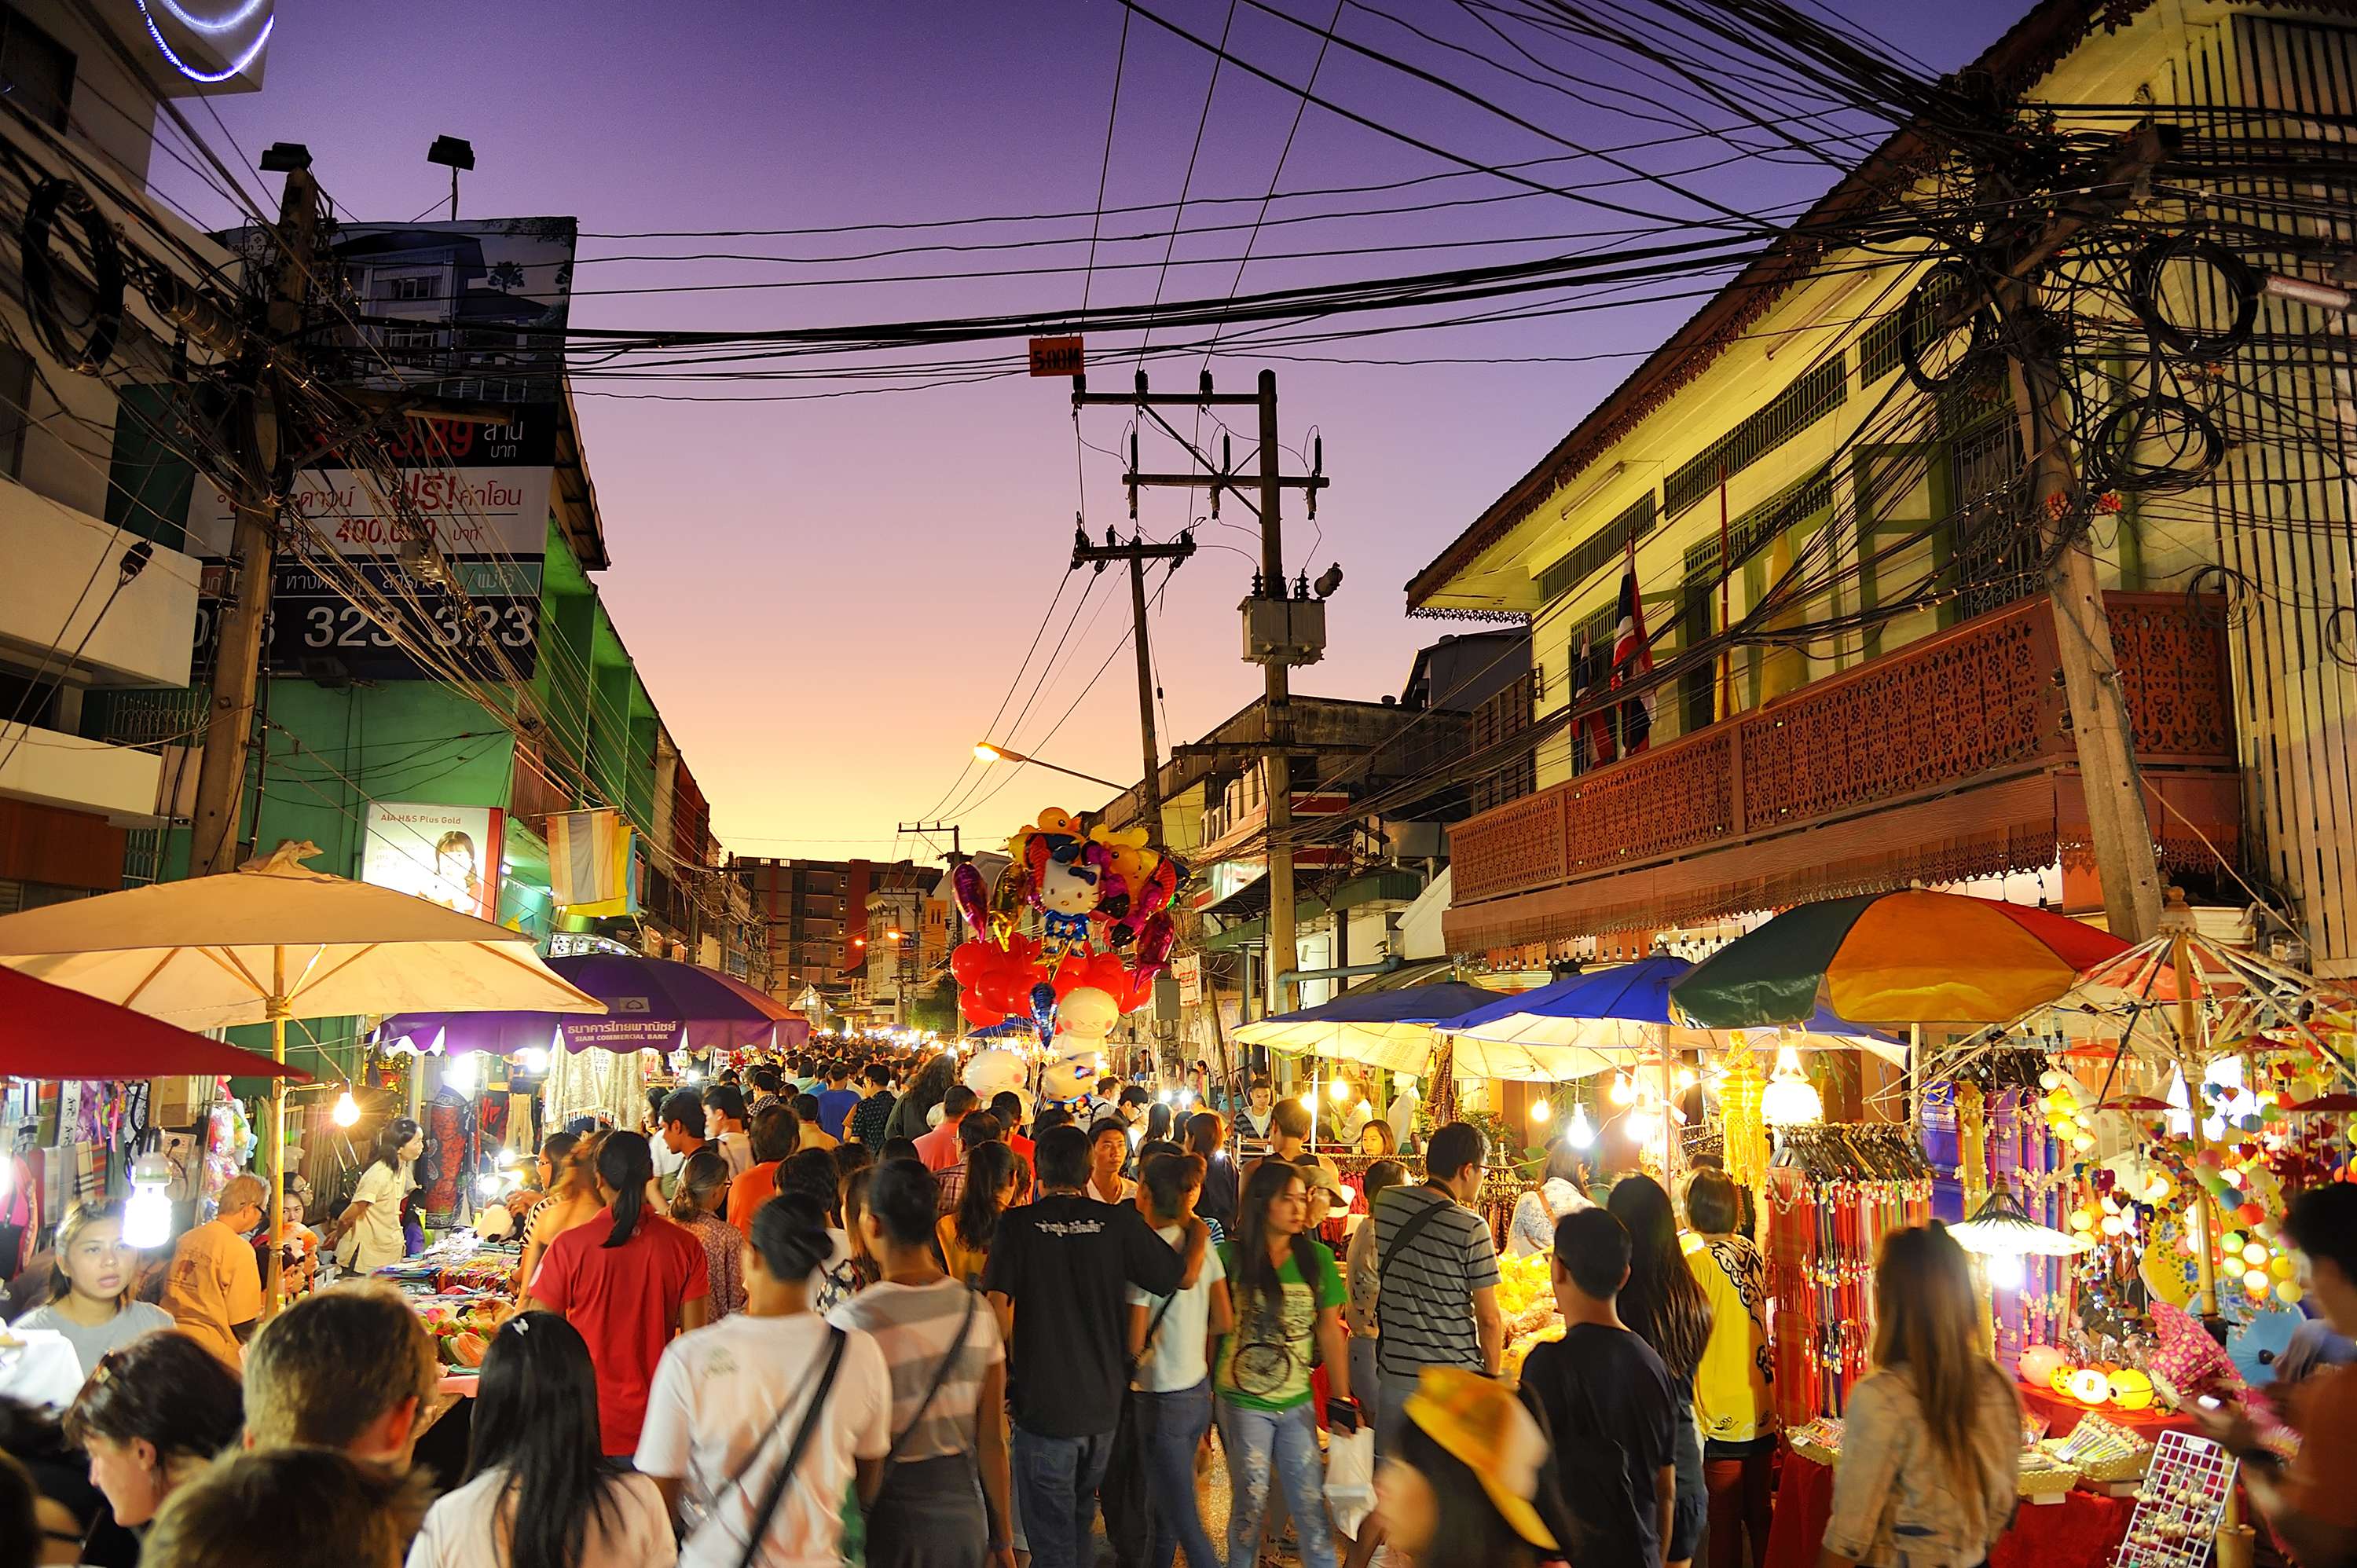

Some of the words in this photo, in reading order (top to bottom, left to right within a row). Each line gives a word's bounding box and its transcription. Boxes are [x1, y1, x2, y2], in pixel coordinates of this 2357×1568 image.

[484, 421, 524, 441] ลาน
[490, 445, 517, 459] บาท
[459, 480, 522, 506] ค่าโอน
[304, 606, 402, 648] 323
[432, 605, 534, 647] 323
[441, 816, 461, 825] Gold
[567, 1020, 676, 1034] ธนาคารไทยพาณิชย์
